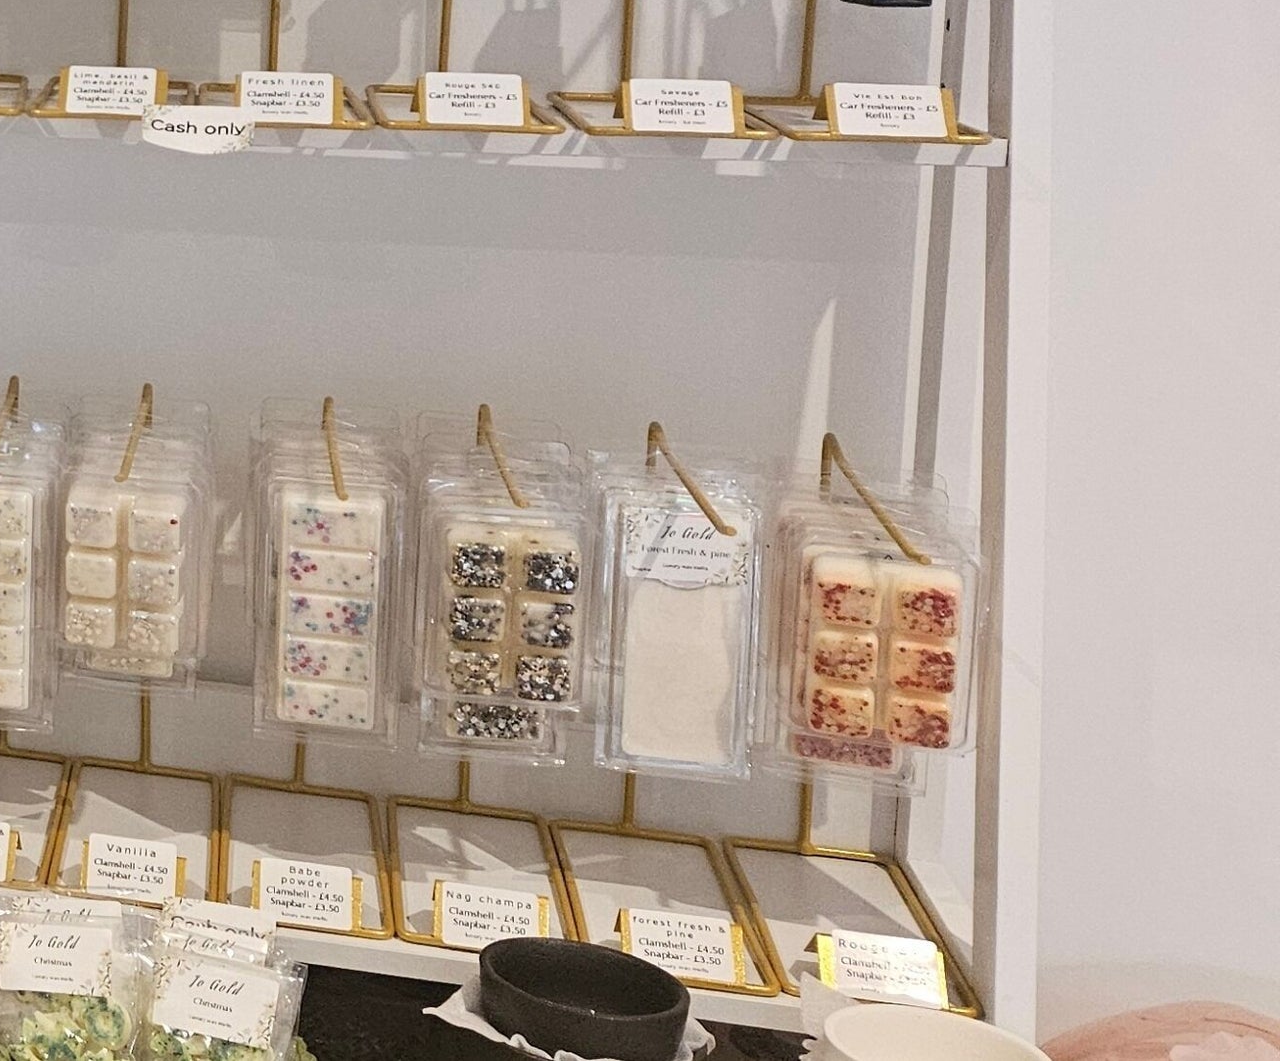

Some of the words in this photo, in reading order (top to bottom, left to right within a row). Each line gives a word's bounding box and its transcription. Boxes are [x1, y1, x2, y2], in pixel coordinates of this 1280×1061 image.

[74, 87, 115, 95] Clamshell
[840, 102, 858, 110] Car
[151, 119, 197, 134] Cash
[205, 123, 246, 136] only
[107, 843, 157, 858] Vanilla
[94, 858, 135, 870] Clamshell
[144, 865, 168, 875] £4.50
[289, 866, 321, 877] Babe
[97, 869, 131, 880] Snapbar
[140, 875, 164, 885] £3.50
[281, 877, 329, 889] powder
[266, 886, 310, 899] Clamshell
[319, 893, 344, 903] £4.50
[446, 891, 471, 902] Nag
[479, 896, 532, 910] champa
[270, 897, 306, 909] Snapbar
[315, 904, 340, 913] £3.50
[449, 907, 494, 920] Clamshell
[504, 916, 530, 925] £4.50
[453, 918, 490, 930] Snapbar
[500, 925, 526, 935] £3.50
[633, 916, 671, 927] forest
[678, 922, 712, 932] fresh
[719, 926, 726, 934] &
[28, 935, 42, 949] Jo
[47, 935, 81, 949] Gold
[666, 930, 694, 939] pine
[639, 937, 687, 950] Clamshell
[697, 945, 725, 955] £4.50
[34, 956, 73, 967] Christmas
[644, 949, 684, 961] Snapbar
[694, 956, 721, 966] £3.50
[189, 975, 205, 988] Jo
[210, 979, 245, 996] Gold
[194, 997, 233, 1013] Christmas
